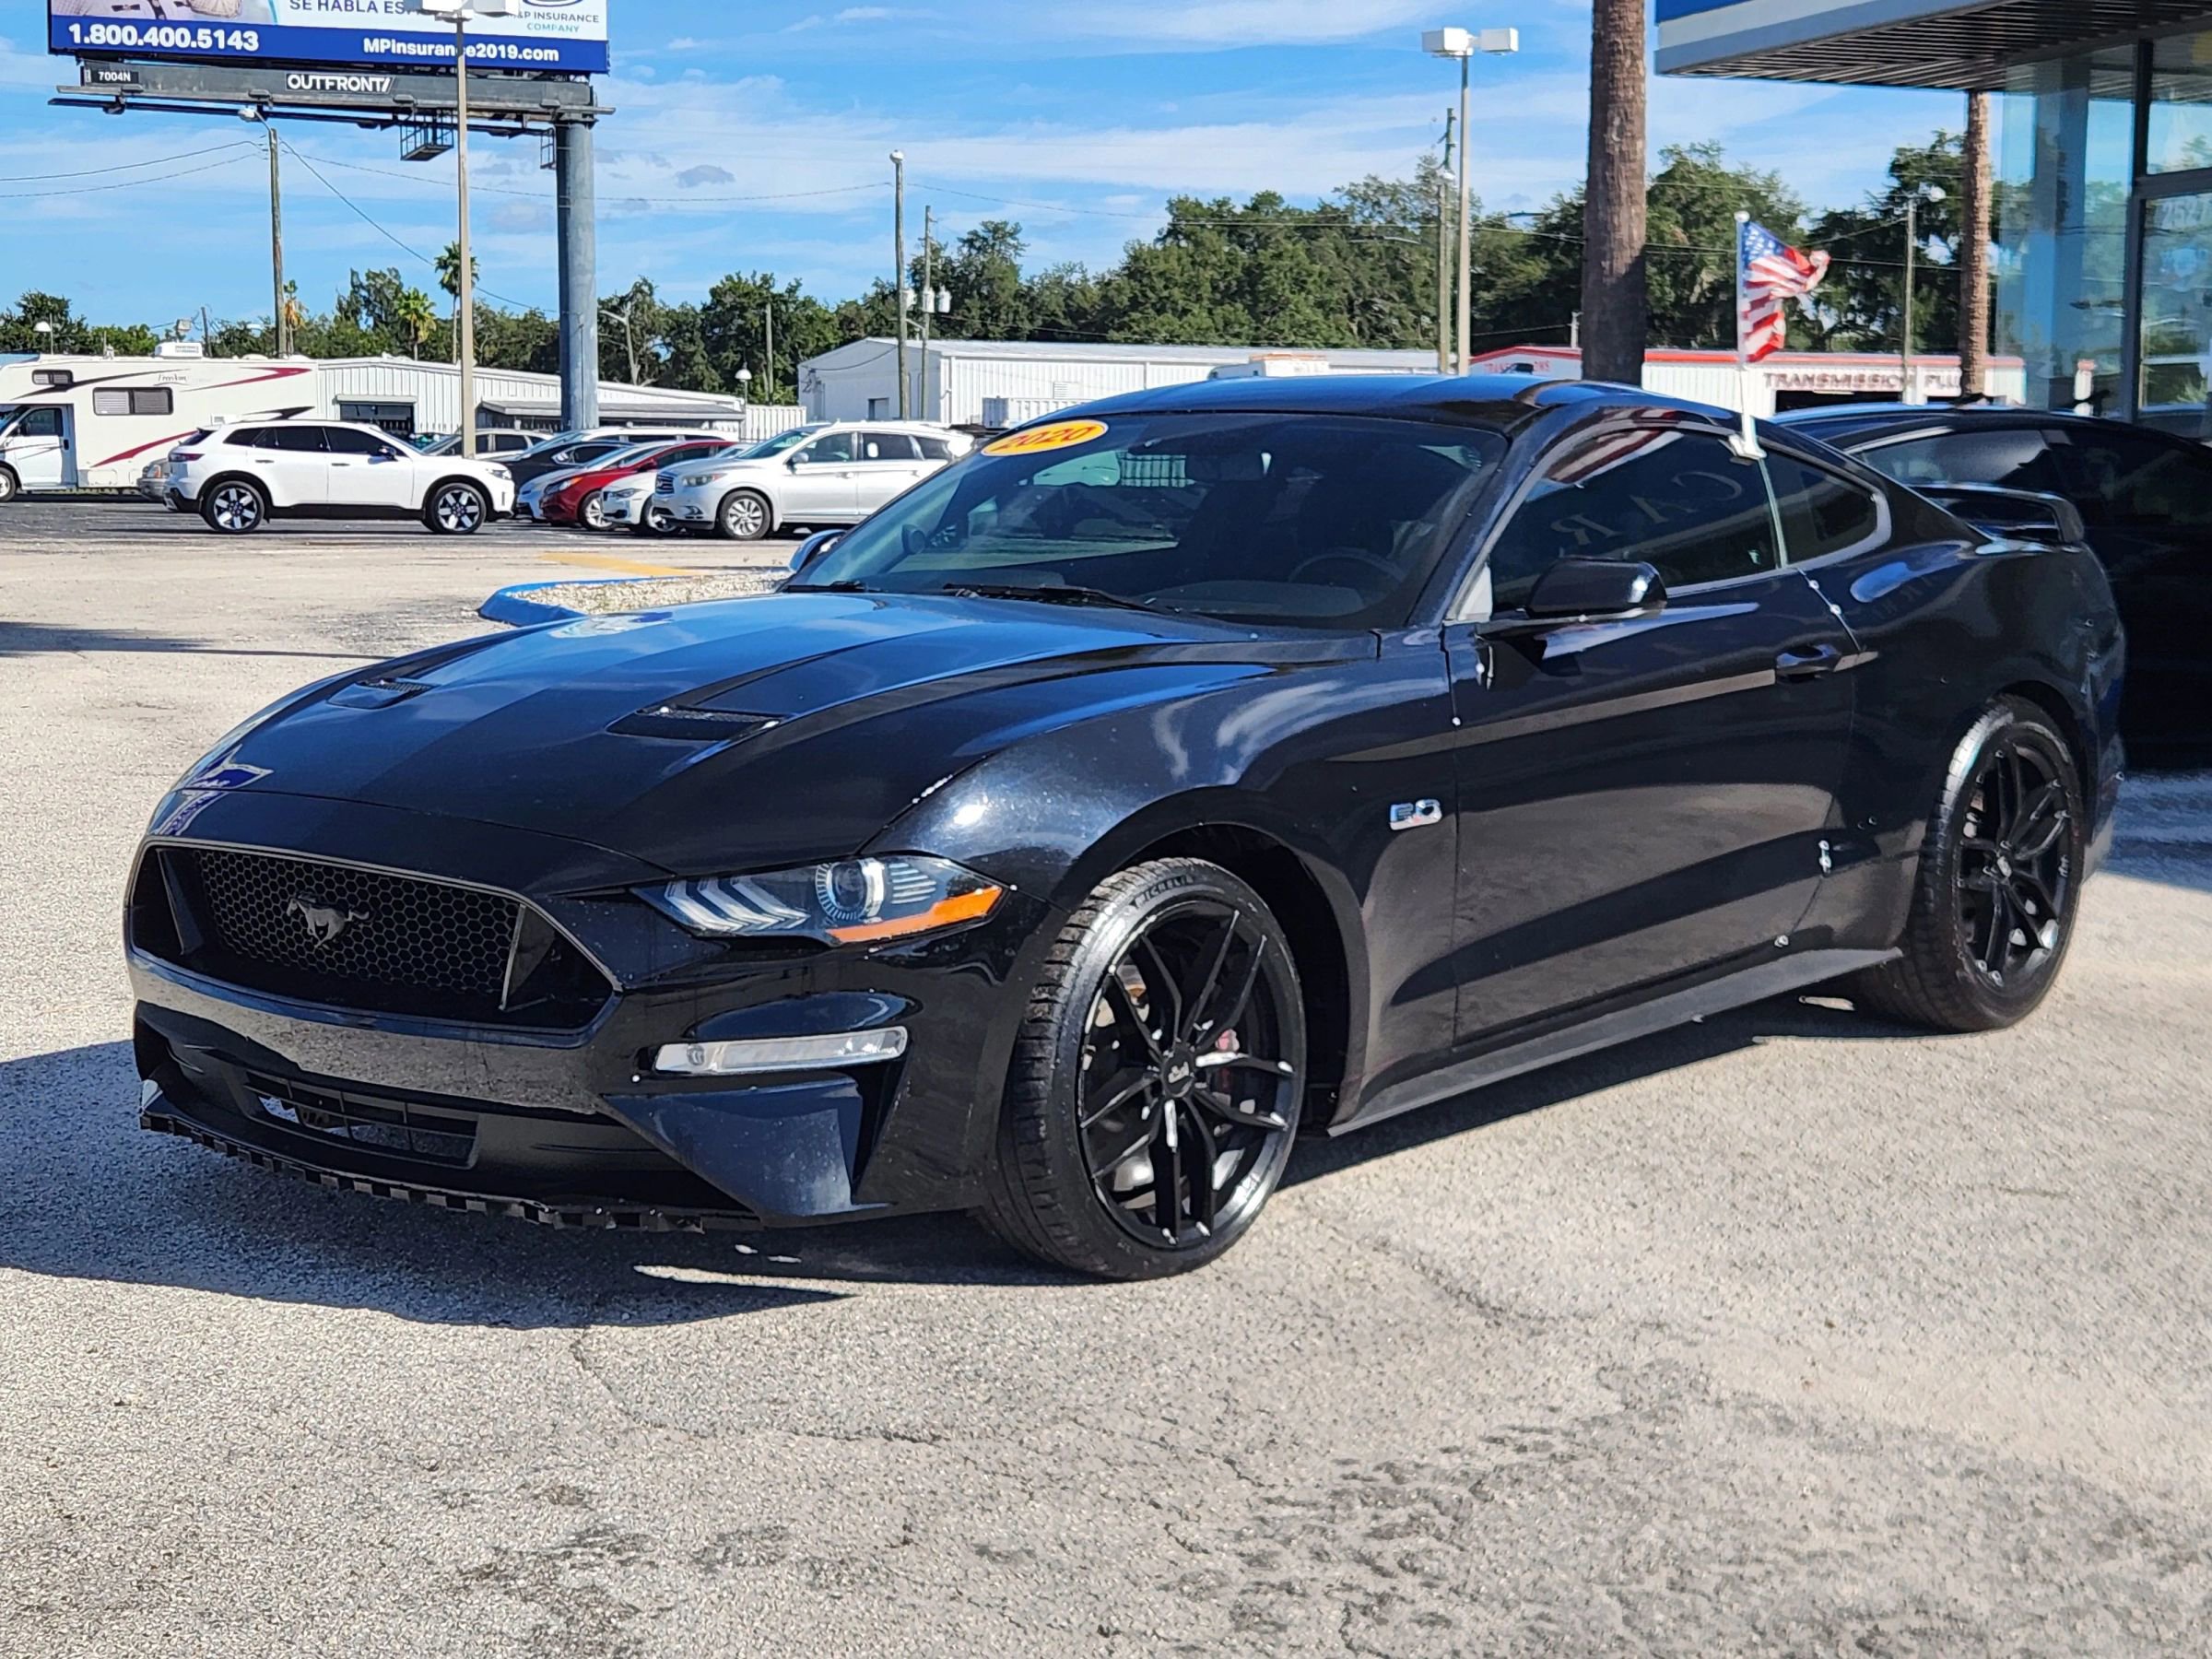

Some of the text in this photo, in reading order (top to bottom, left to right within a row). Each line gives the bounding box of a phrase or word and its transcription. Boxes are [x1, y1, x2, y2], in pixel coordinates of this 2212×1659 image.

[289, 0, 312, 10] SE
[317, 0, 379, 14] HABLA
[534, 11, 600, 23] INSURANCE
[526, 22, 580, 33] COMPANY
[68, 23, 260, 52] 1.800.400.5143
[98, 71, 131, 82] 7004N
[991, 426, 1097, 452] 2020
